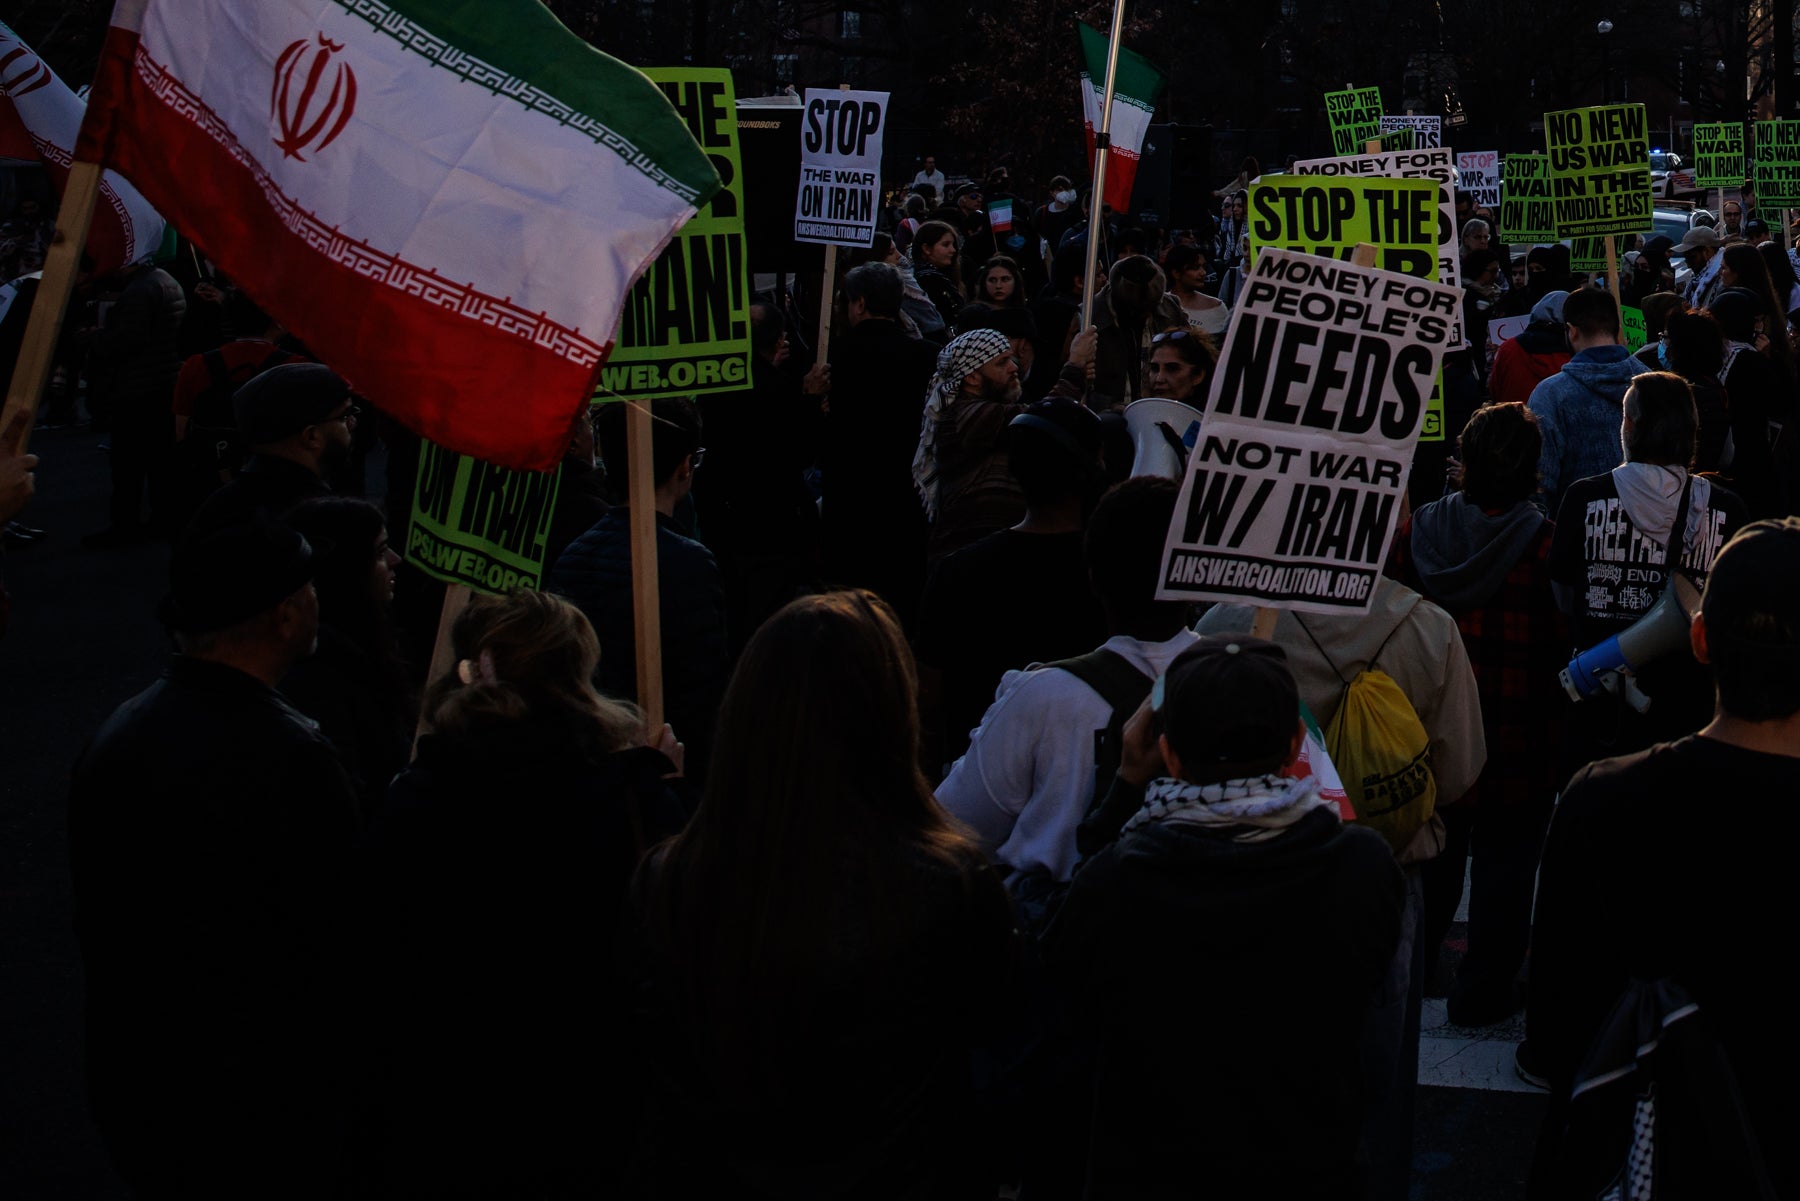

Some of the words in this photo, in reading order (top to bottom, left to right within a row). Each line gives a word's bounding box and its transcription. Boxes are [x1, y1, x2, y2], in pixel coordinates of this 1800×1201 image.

[1327, 91, 1356, 111] STOP
[1357, 90, 1380, 108] THE
[656, 82, 731, 147] HE
[1330, 107, 1382, 127] WAR
[805, 98, 881, 156] STOP
[1548, 112, 1583, 147] NO
[1588, 107, 1643, 143] NEW
[1696, 126, 1721, 140] STOP
[1724, 125, 1742, 139] THE
[1757, 123, 1773, 145] NO
[1334, 128, 1355, 155] ON
[1696, 140, 1743, 154] WAR
[1299, 157, 1389, 176] MONEY
[1395, 152, 1449, 169] FOR
[1460, 153, 1496, 169] STOP
[1550, 146, 1587, 172] US
[1588, 140, 1648, 168] WAR
[1757, 146, 1774, 162] US
[804, 168, 831, 183] THE
[834, 170, 876, 186] WAR
[1460, 171, 1484, 187] WAR
[1506, 159, 1540, 178] STOP
[1697, 156, 1712, 179] ON
[1714, 155, 1744, 178] IRAN!
[1757, 166, 1773, 180] IN
[1553, 176, 1586, 198] IN
[1588, 171, 1649, 194] THE
[1697, 179, 1743, 187] PSLWEB.ORG
[1759, 181, 1786, 197] MIDDLE
[801, 185, 823, 217] ON
[828, 186, 873, 222] IRAN
[1472, 189, 1498, 205] RAN
[1555, 196, 1612, 223] MIDDLE
[1614, 192, 1650, 218] EAST
[1254, 186, 1356, 242] STOP
[1363, 188, 1432, 244] THE
[1503, 200, 1524, 231] ON
[797, 221, 871, 241] ANSWERCOALITION.ORG
[1503, 234, 1553, 243] PSLWEB.OR
[1570, 226, 1585, 234] PARTY
[1586, 225, 1596, 233] FOR
[1590, 234, 1623, 259] IR!
[1571, 262, 1620, 270] PSLWEB.OG
[622, 233, 747, 348] IRAN!
[1257, 256, 1379, 298] MONEY
[1382, 279, 1458, 315] FOR
[1245, 281, 1448, 344] PEOPLE'S
[601, 356, 746, 391] WEB.ORG
[1215, 313, 1434, 440] NEEDS
[1200, 435, 1301, 474] NOT
[1310, 451, 1402, 488] WAR
[458, 457, 559, 564] IRAN!
[1182, 469, 1277, 548] W/
[1275, 483, 1396, 565] IRAN
[1584, 497, 1628, 562] FREE
[1169, 554, 1370, 601] ANSWERCOALITION.ORG
[1627, 569, 1662, 584] END
